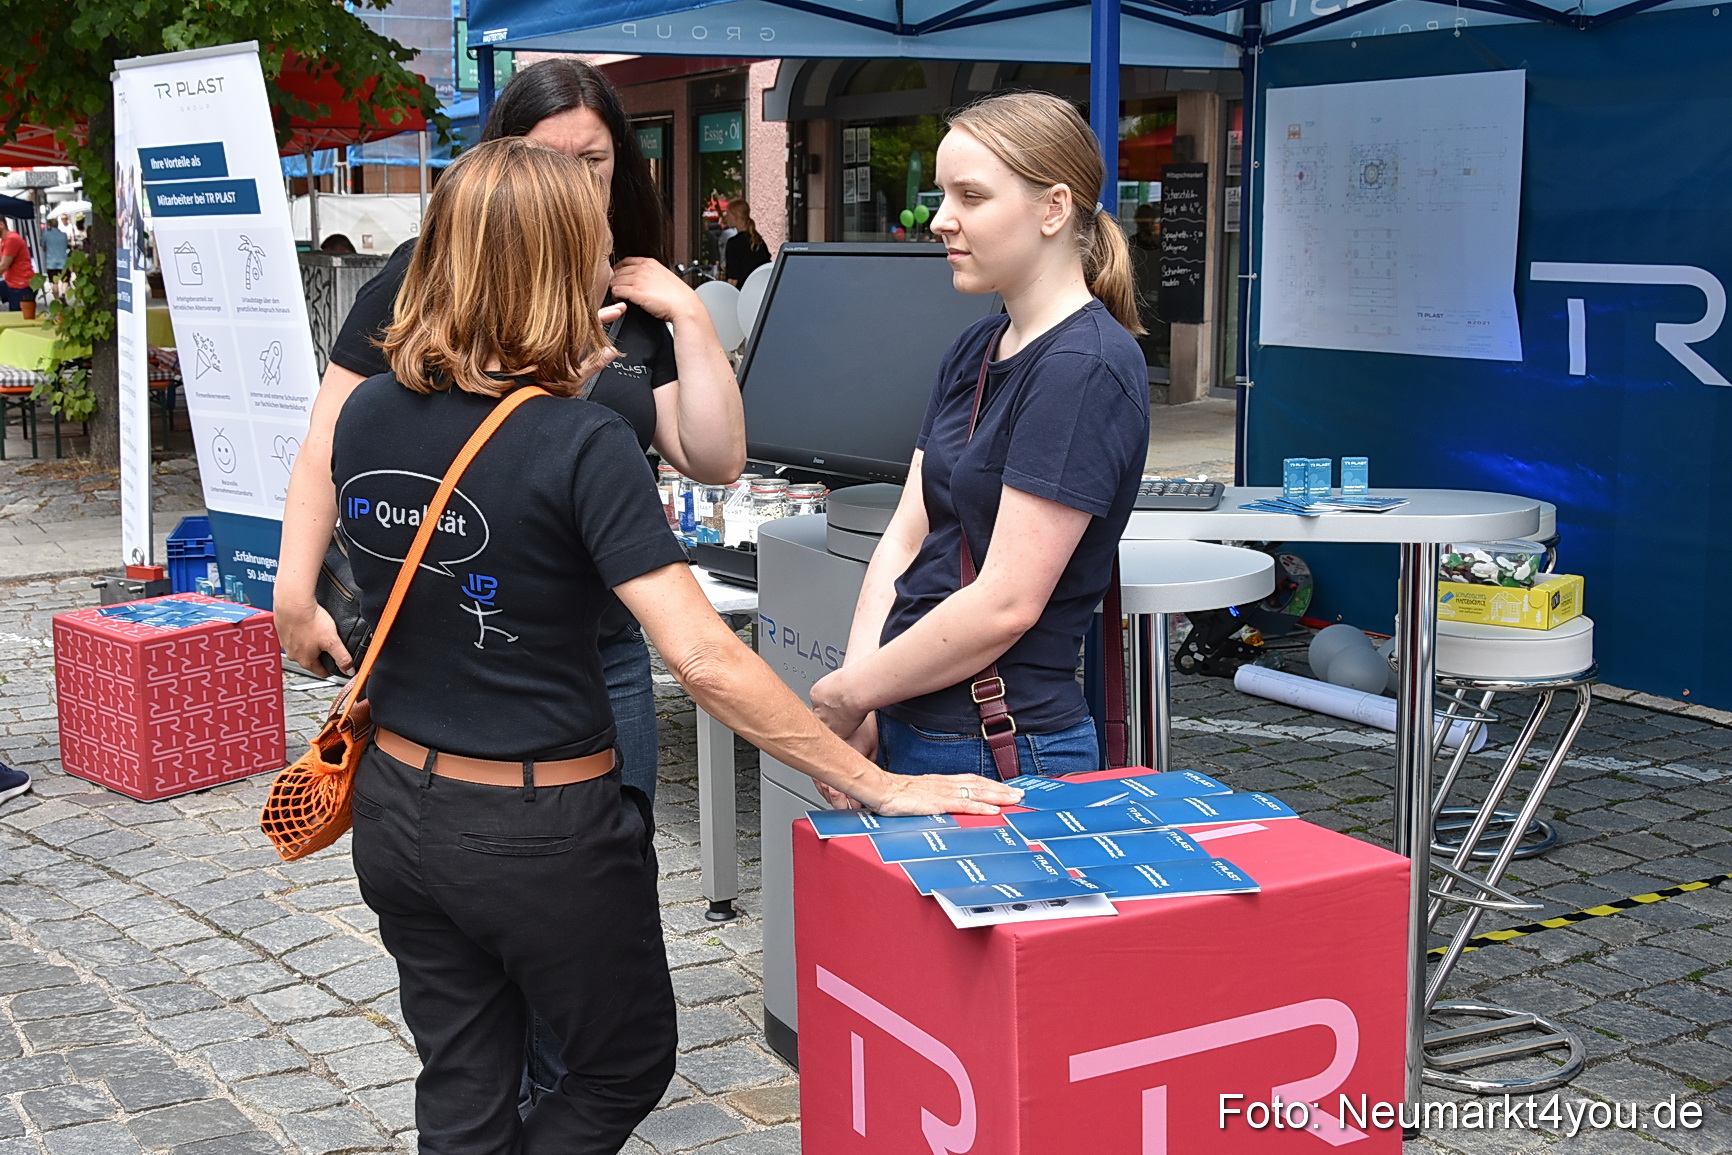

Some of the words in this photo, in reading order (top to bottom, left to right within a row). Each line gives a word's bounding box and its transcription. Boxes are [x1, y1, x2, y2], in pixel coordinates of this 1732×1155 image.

[154, 83, 172, 99] TR
[176, 77, 224, 97] PLAST
[704, 124, 723, 144] Essig
[729, 119, 740, 140] Öl
[150, 157, 165, 170] Ihre
[164, 155, 189, 169] Vorteile
[191, 154, 202, 167] als
[157, 193, 194, 206] Mitarbeiter
[194, 192, 206, 205] bei
[205, 192, 216, 204] TR
[216, 192, 236, 204] PLAST
[612, 361, 648, 375] PLAST
[375, 501, 467, 537] Qualtät
[246, 568, 256, 580] 50
[1038, 858, 1059, 876] PLAST
[1219, 864, 1243, 882] PLAST
